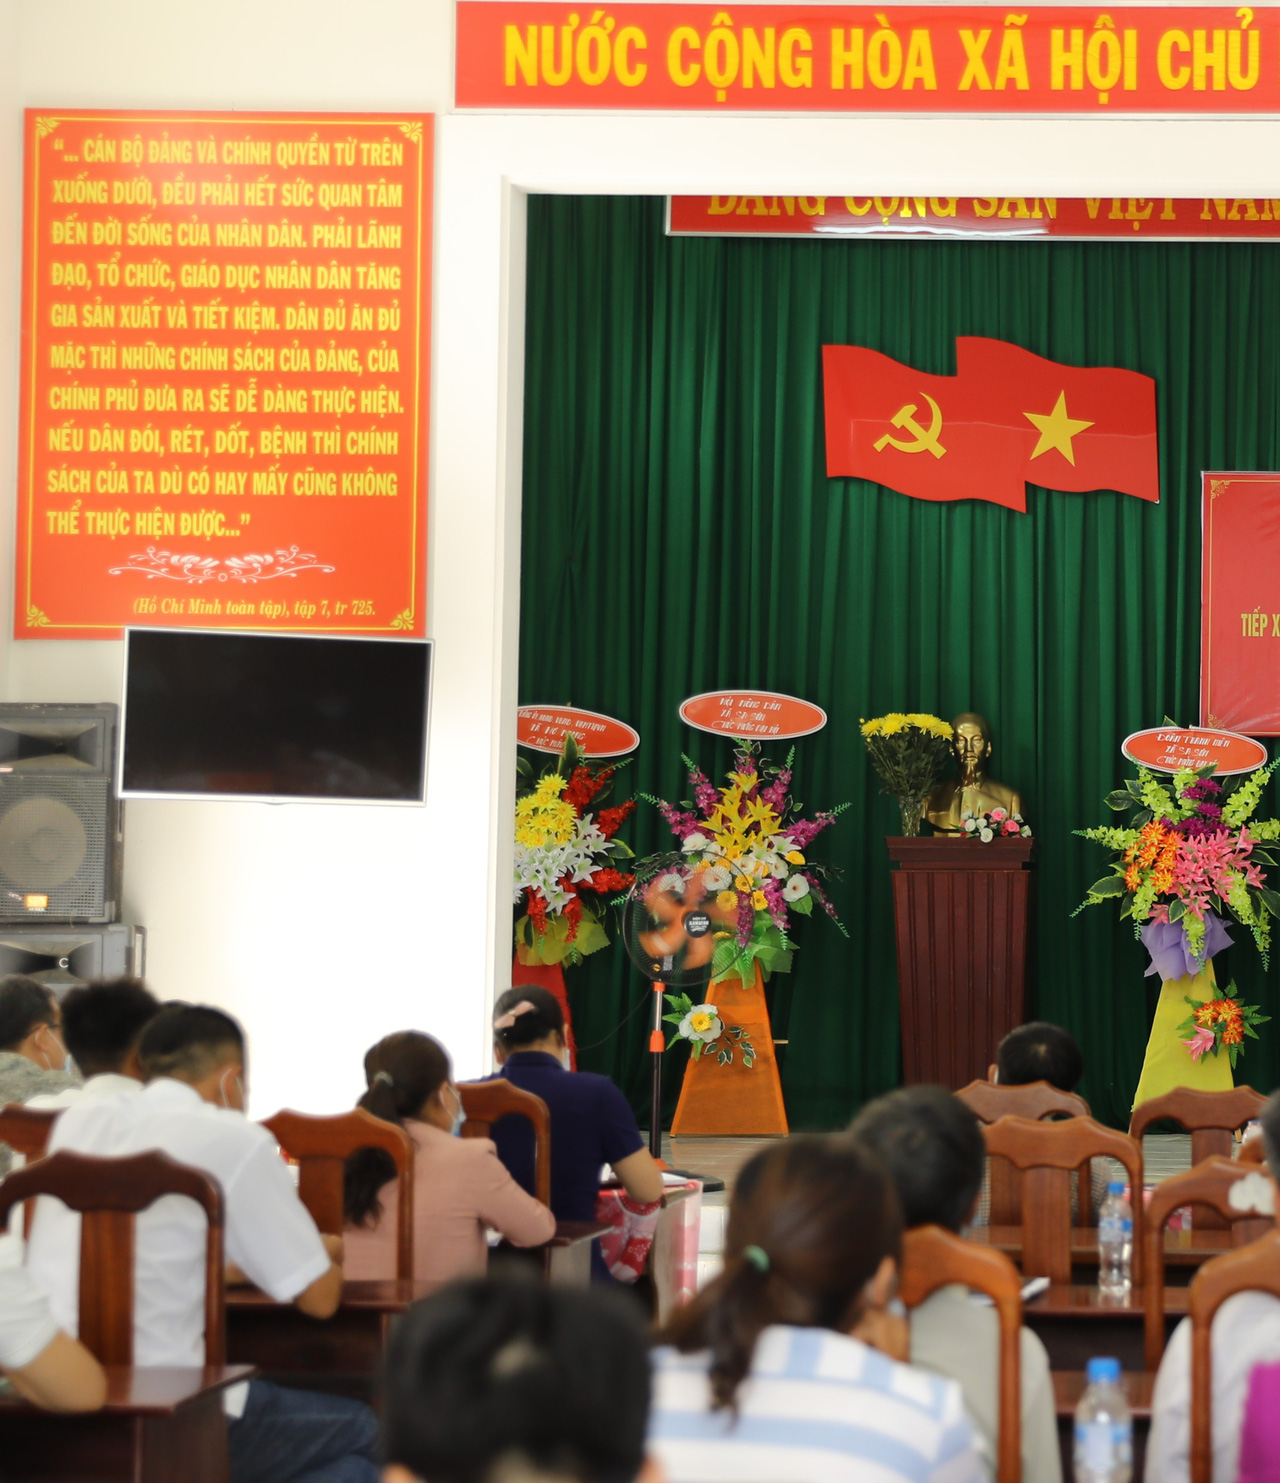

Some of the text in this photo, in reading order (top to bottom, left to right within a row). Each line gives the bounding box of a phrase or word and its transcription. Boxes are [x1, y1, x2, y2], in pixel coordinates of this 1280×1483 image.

[504, 10, 648, 87] NƯỚC
[666, 11, 813, 102] CỘNG
[830, 13, 938, 90] HÒA
[958, 13, 1030, 90] XÃ
[1050, 14, 1138, 104] HỘI
[1157, 8, 1260, 90] CHỦ
[82, 134, 117, 162] CÁN
[120, 135, 144, 165] BỘ
[148, 133, 192, 163] ĐẢNG
[196, 136, 217, 162] VÀ
[222, 136, 272, 164] CHÍNH
[276, 132, 332, 168] QUYỀN
[332, 136, 359, 166] TỪ
[360, 137, 404, 167] TRÊN
[52, 173, 404, 210] XUỐNG DƯỚI, ĐỀU PHẢI HẾT SỨC QUAN TÂM
[133, 597, 376, 619] (Hồ Chí Minh toàn tập), tập 7, tr 725.
[1241, 606, 1268, 636] TIẾP
